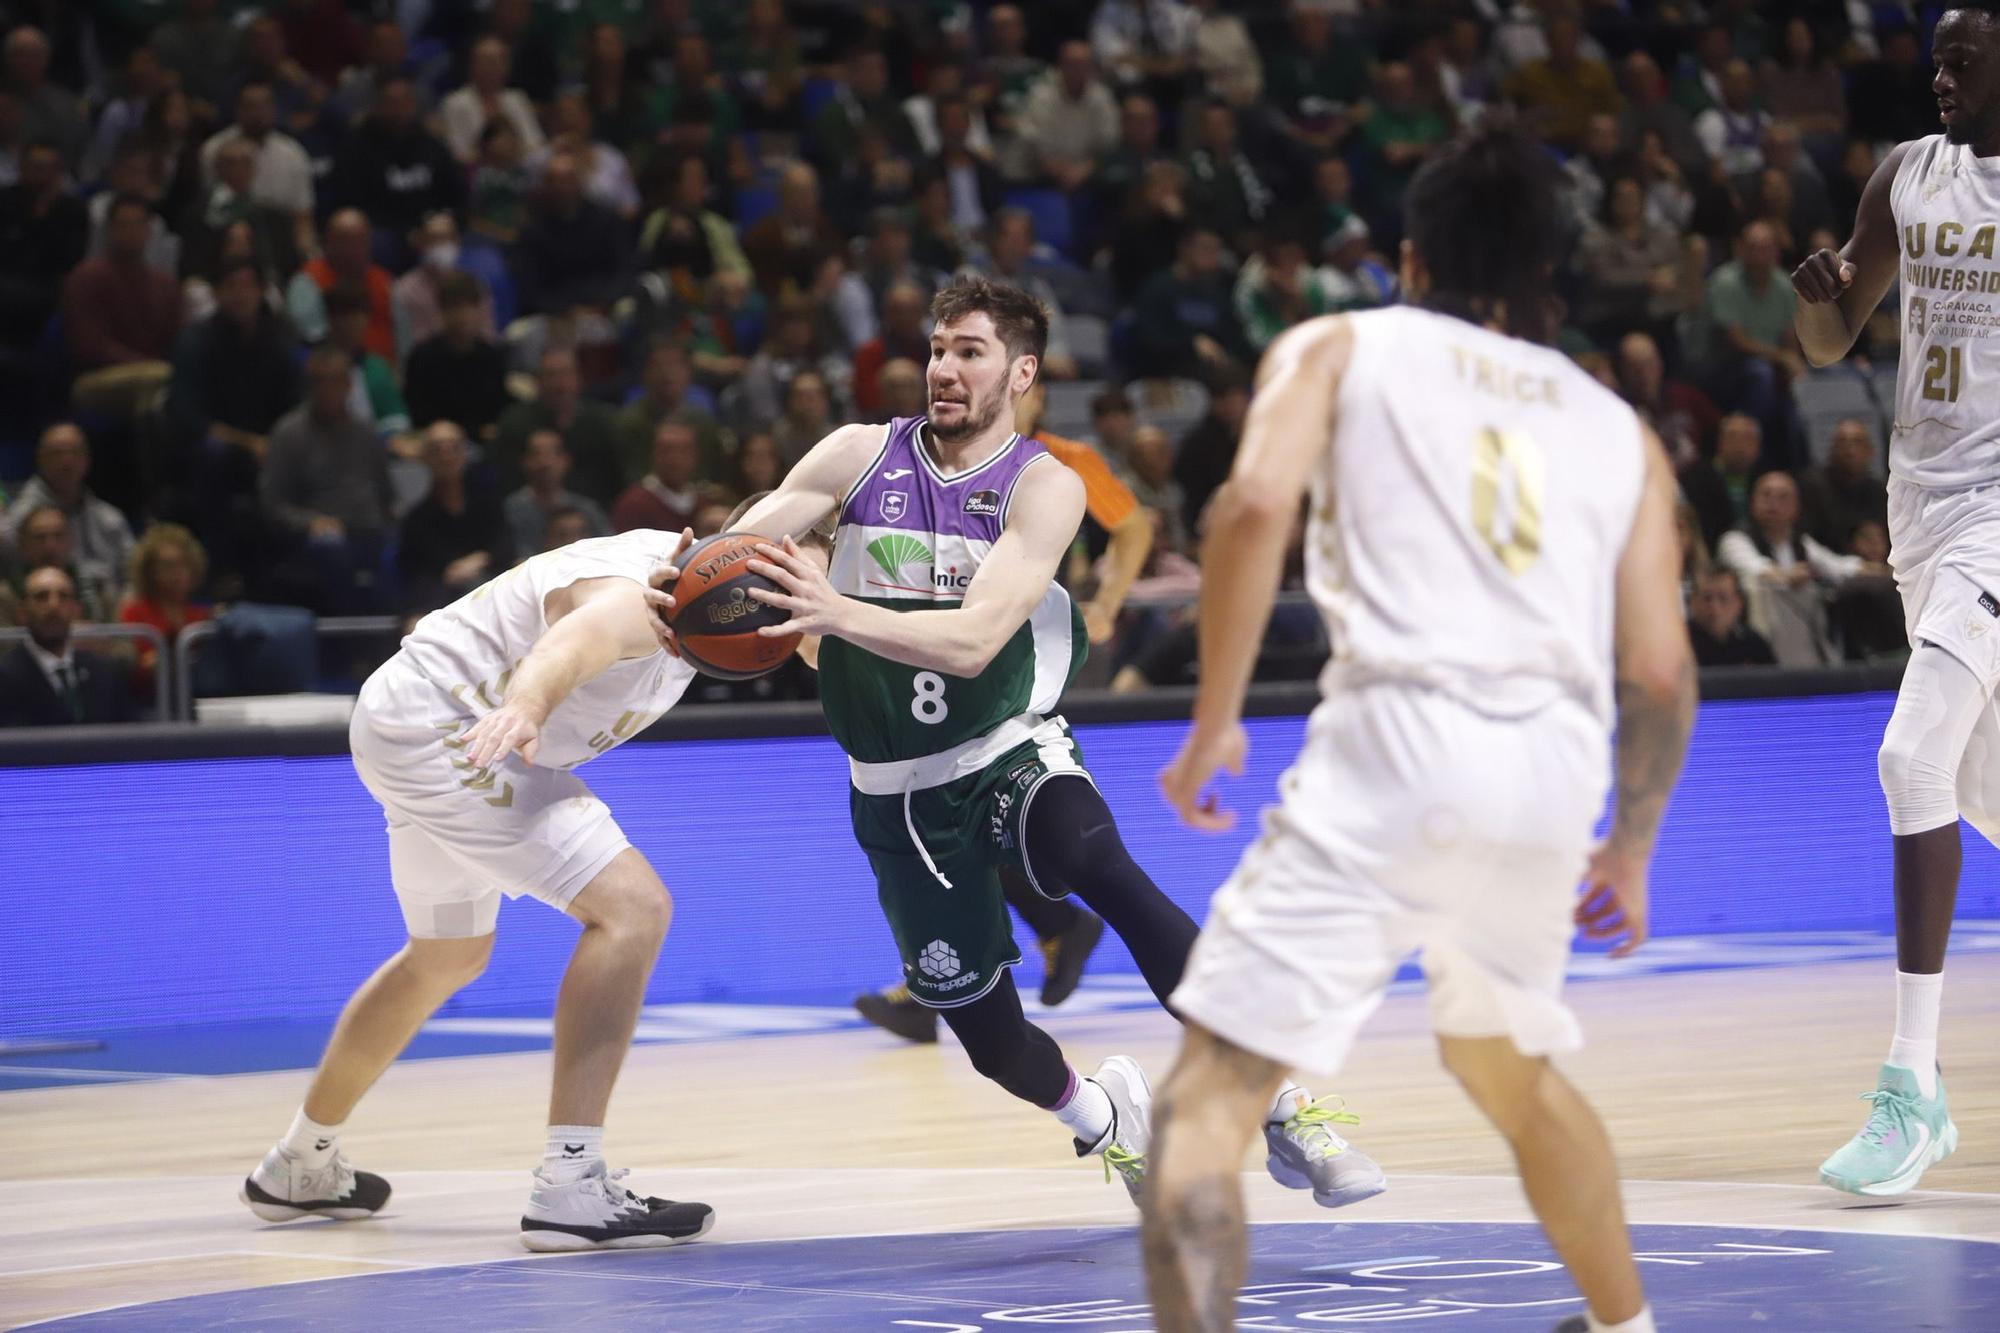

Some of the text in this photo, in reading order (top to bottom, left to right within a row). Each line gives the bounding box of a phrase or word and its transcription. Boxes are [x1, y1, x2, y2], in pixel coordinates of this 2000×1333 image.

[1905, 222, 1996, 260] UCA
[1931, 313, 1943, 323] DE
[1946, 313, 1956, 323] LA
[1933, 301, 1992, 313] CARAVACA
[1450, 344, 1563, 410] TRICE
[1922, 344, 1961, 402] 21
[1471, 424, 1545, 578] 0
[911, 670, 948, 724] 8
